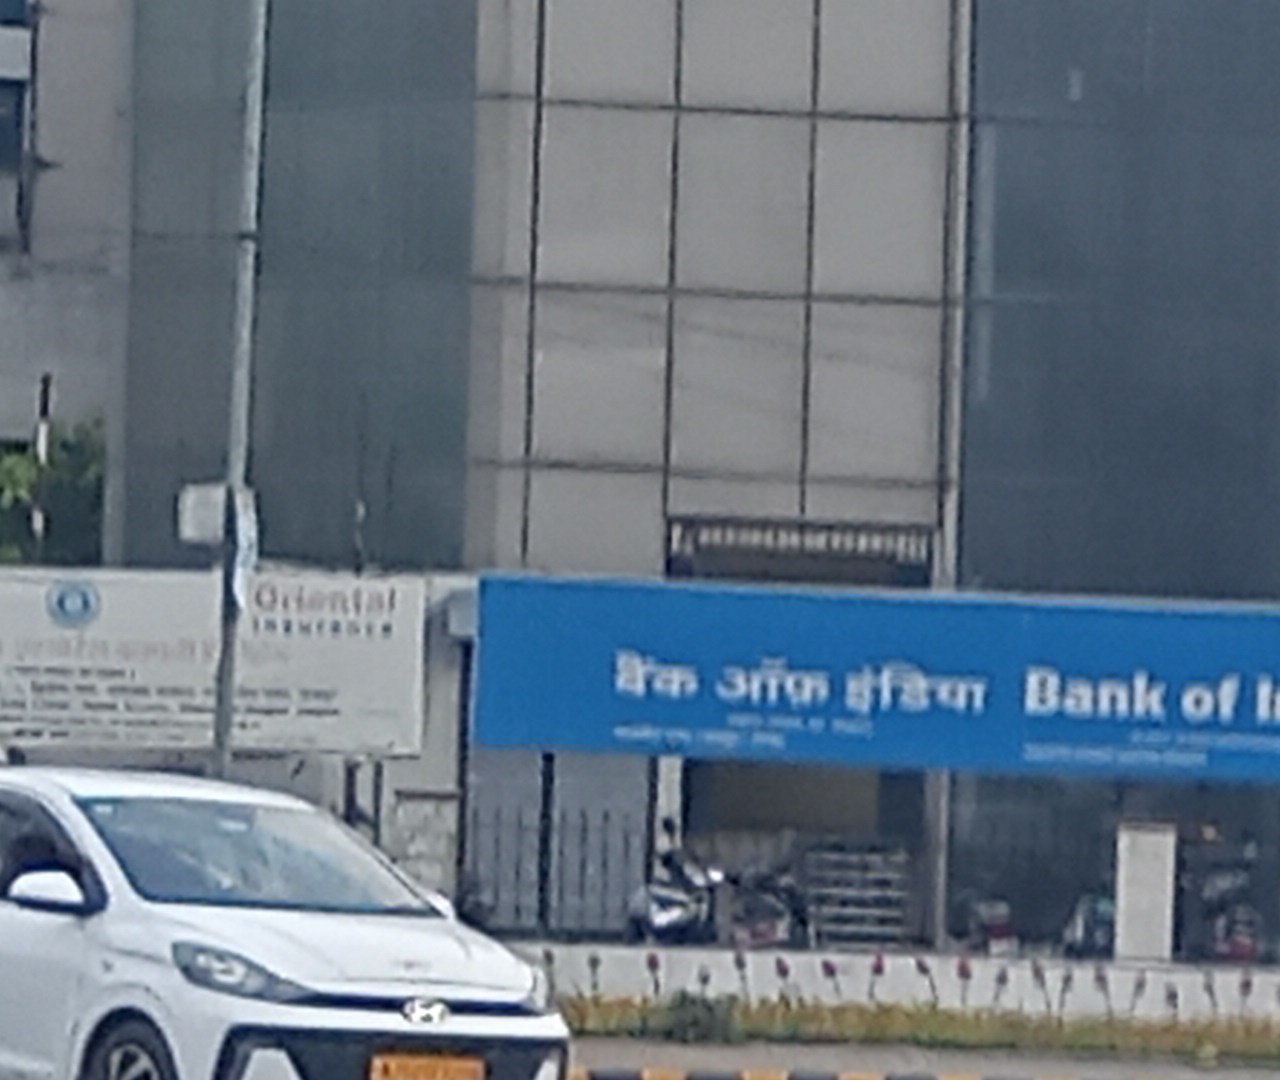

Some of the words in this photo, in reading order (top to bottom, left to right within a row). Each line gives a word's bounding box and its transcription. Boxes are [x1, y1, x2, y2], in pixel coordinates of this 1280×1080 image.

[254, 583, 397, 614] Oriental
[614, 649, 697, 697] बैंक
[844, 658, 988, 716] इंडिया
[1022, 664, 1166, 720] Bank
[1179, 672, 1241, 726] of
